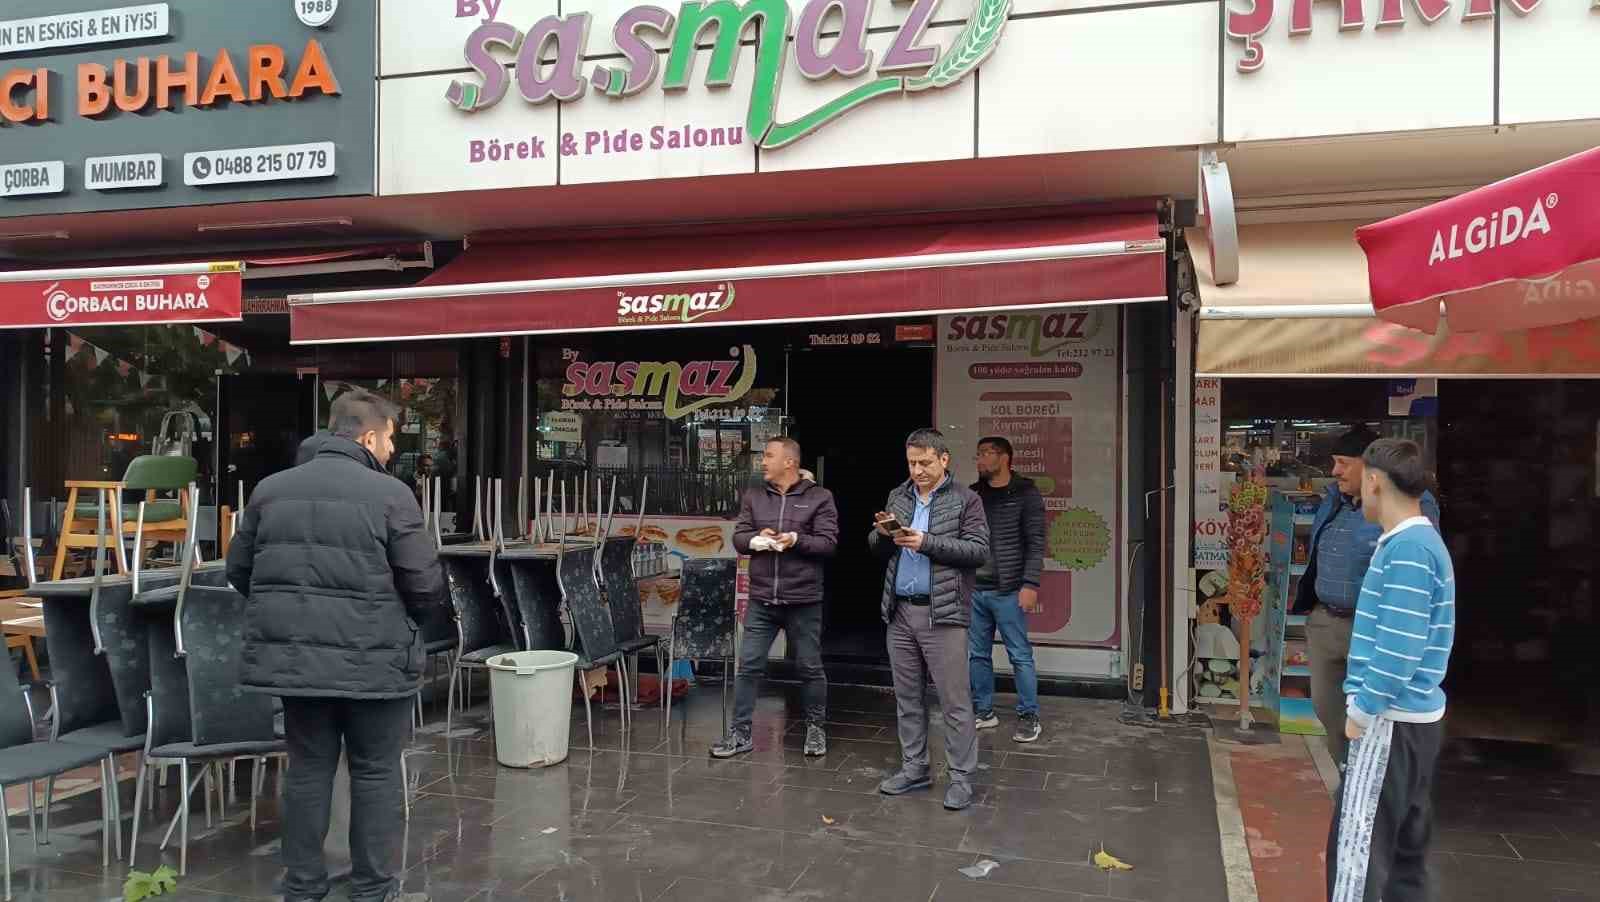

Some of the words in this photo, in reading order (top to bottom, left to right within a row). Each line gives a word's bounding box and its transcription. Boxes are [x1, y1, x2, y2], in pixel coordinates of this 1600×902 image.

[301, 1, 332, 14] 1988
[16, 26, 35, 44] EN
[87, 18, 98, 36] &
[101, 15, 121, 35] EN
[77, 38, 340, 117] BUHARA
[469, 136, 545, 163] Börek
[560, 132, 578, 156] &
[584, 128, 644, 155] Pide
[649, 124, 743, 151] Salonu
[90, 160, 157, 184] MUMBAR
[215, 156, 252, 176] 0488
[257, 154, 283, 173] 215
[286, 152, 305, 171] 07
[308, 150, 328, 169] 79
[4, 166, 50, 192] ÇORBA
[135, 291, 209, 311] BUHARA
[990, 404, 1013, 416] KOL
